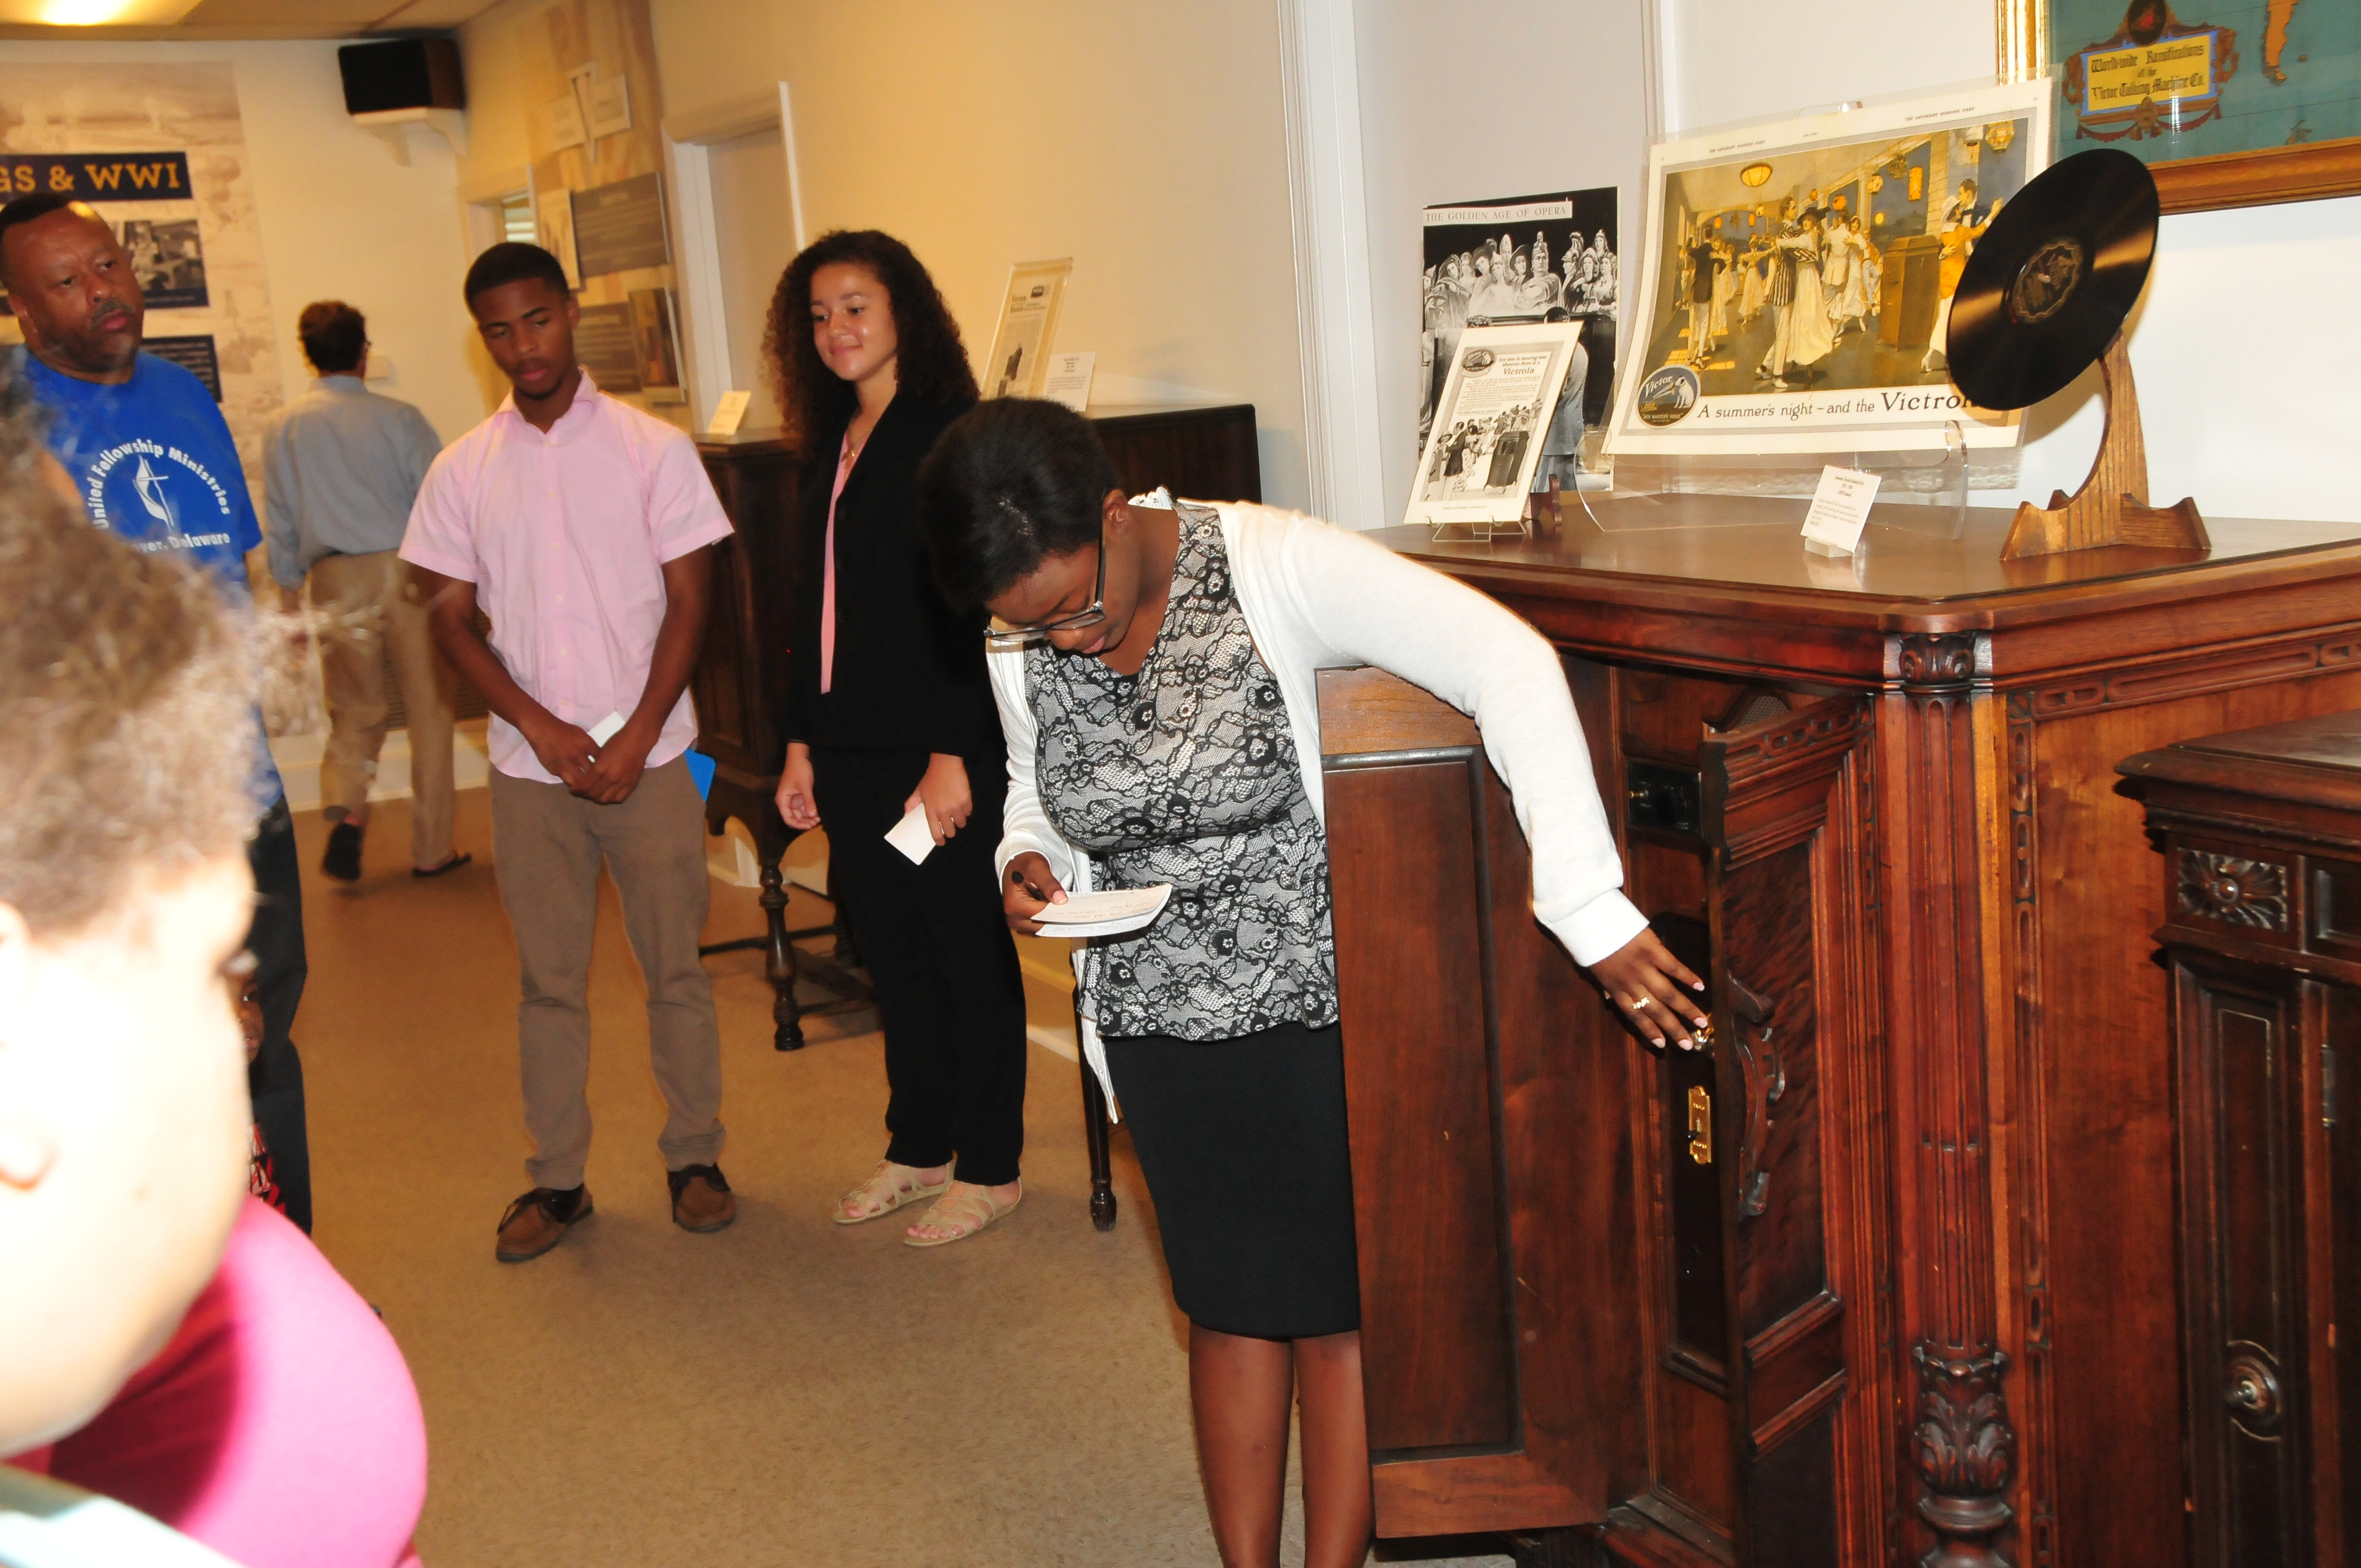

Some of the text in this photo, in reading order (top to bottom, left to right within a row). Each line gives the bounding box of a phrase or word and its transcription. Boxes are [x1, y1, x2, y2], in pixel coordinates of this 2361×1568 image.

[48, 164, 75, 191] &
[84, 161, 181, 190] WWI
[1426, 206, 1566, 222] THE GOLDEN AGE OF OPERA
[1503, 367, 1535, 375] Victrola
[1645, 375, 1674, 399] Victor
[1697, 404, 1710, 418] A
[1715, 404, 1775, 418] summer's
[1781, 402, 1814, 421] night
[1827, 400, 1851, 413] and
[1856, 398, 1875, 412] the
[86, 438, 230, 530] United Fellowship Ministries
[167, 533, 231, 548] Delaware
